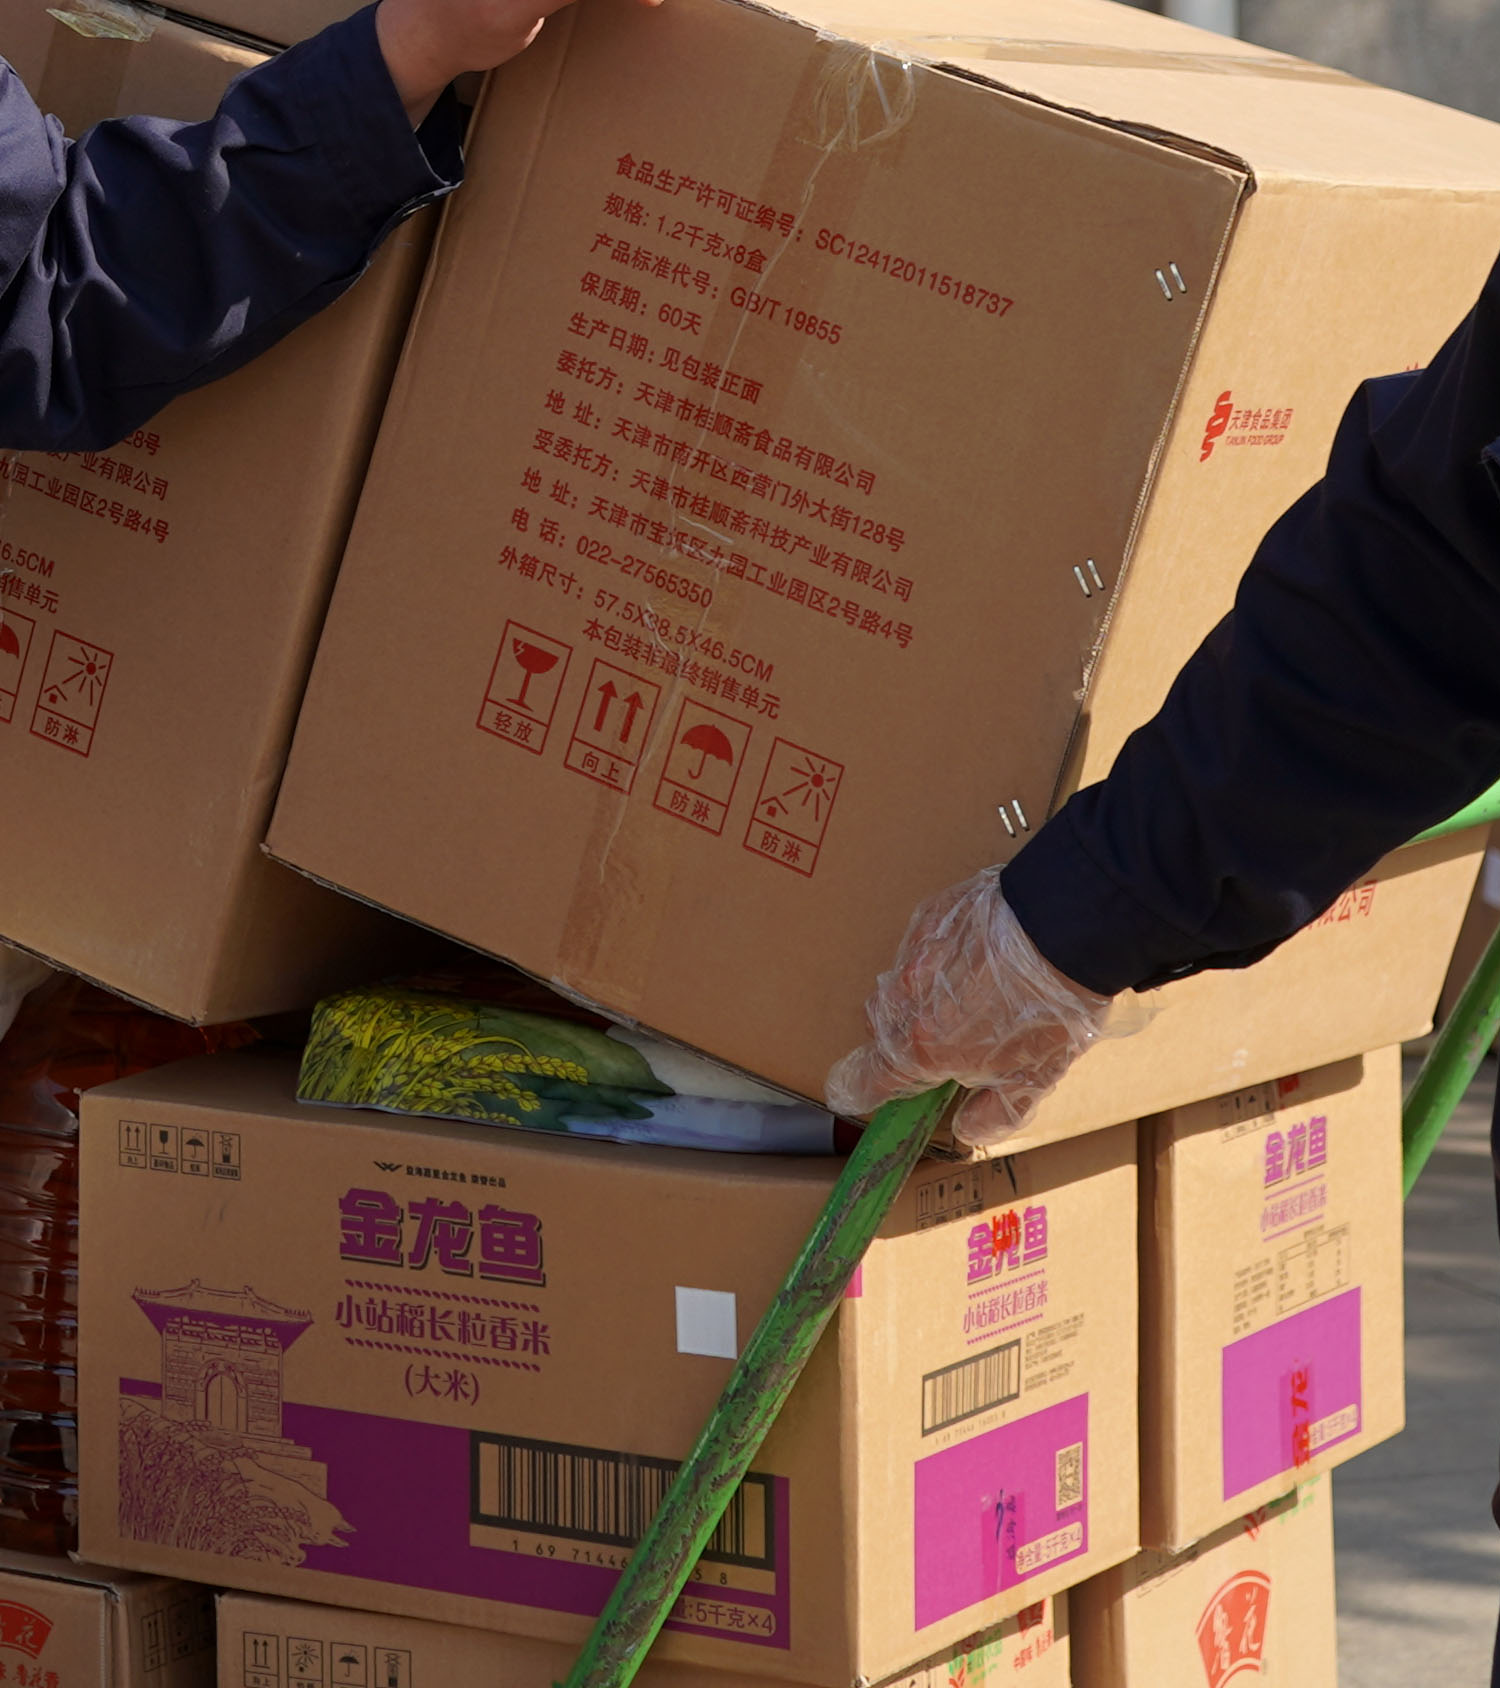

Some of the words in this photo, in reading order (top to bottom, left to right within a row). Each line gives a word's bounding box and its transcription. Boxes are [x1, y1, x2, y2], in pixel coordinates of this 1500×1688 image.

[784, 302, 843, 345] 19855
[1228, 407, 1294, 432] 天津食品集团
[582, 618, 782, 720] 本包装非最终销售单元
[43, 715, 81, 746] 防淋
[492, 710, 535, 744] 轻放
[581, 750, 621, 784] 向上
[670, 790, 712, 823] 防淋
[760, 830, 803, 863] 防淋
[1264, 1115, 1327, 1190] 金龙鱼
[338, 1187, 546, 1288] 金龙鱼
[334, 1294, 553, 1358] 小站稻长粒香米
[963, 1279, 1048, 1334] 小站稻长粒香米
[403, 1363, 480, 1407] (大米)
[1211, 1586, 1260, 1676] 鲁花
